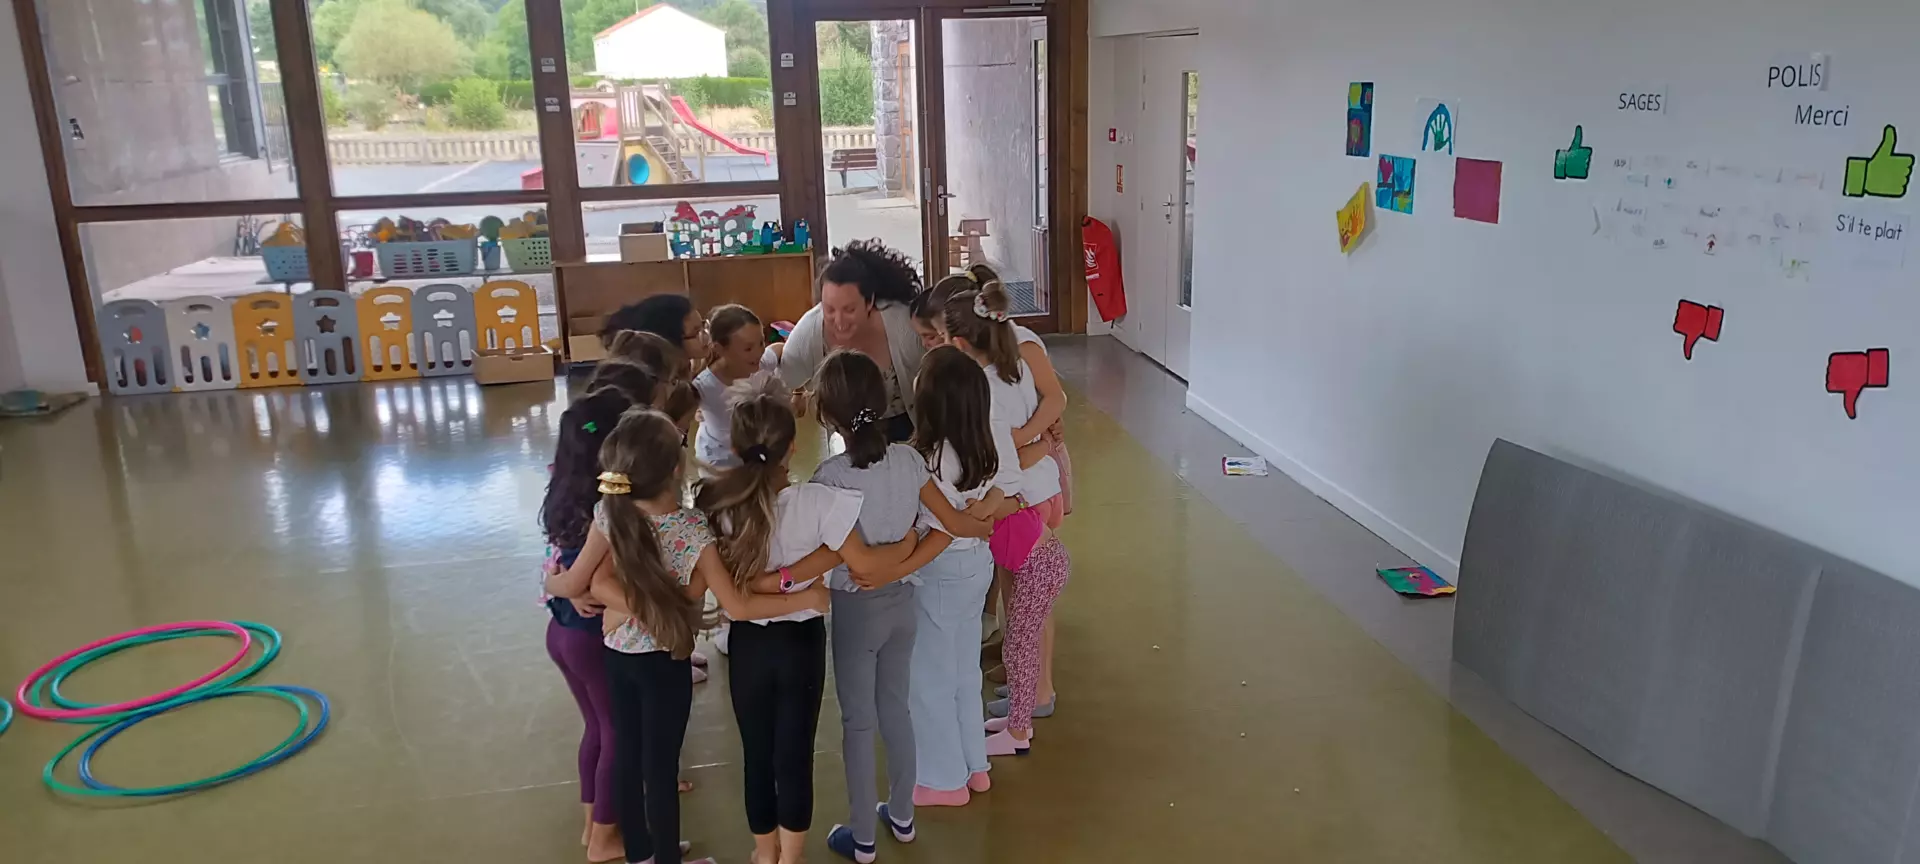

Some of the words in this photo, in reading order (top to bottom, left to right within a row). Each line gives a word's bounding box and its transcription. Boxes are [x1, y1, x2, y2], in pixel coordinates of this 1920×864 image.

[1767, 63, 1822, 88] POLIS
[1618, 92, 1662, 111] SAGES
[1794, 104, 1850, 126] Merci
[1858, 218, 1872, 236] te
